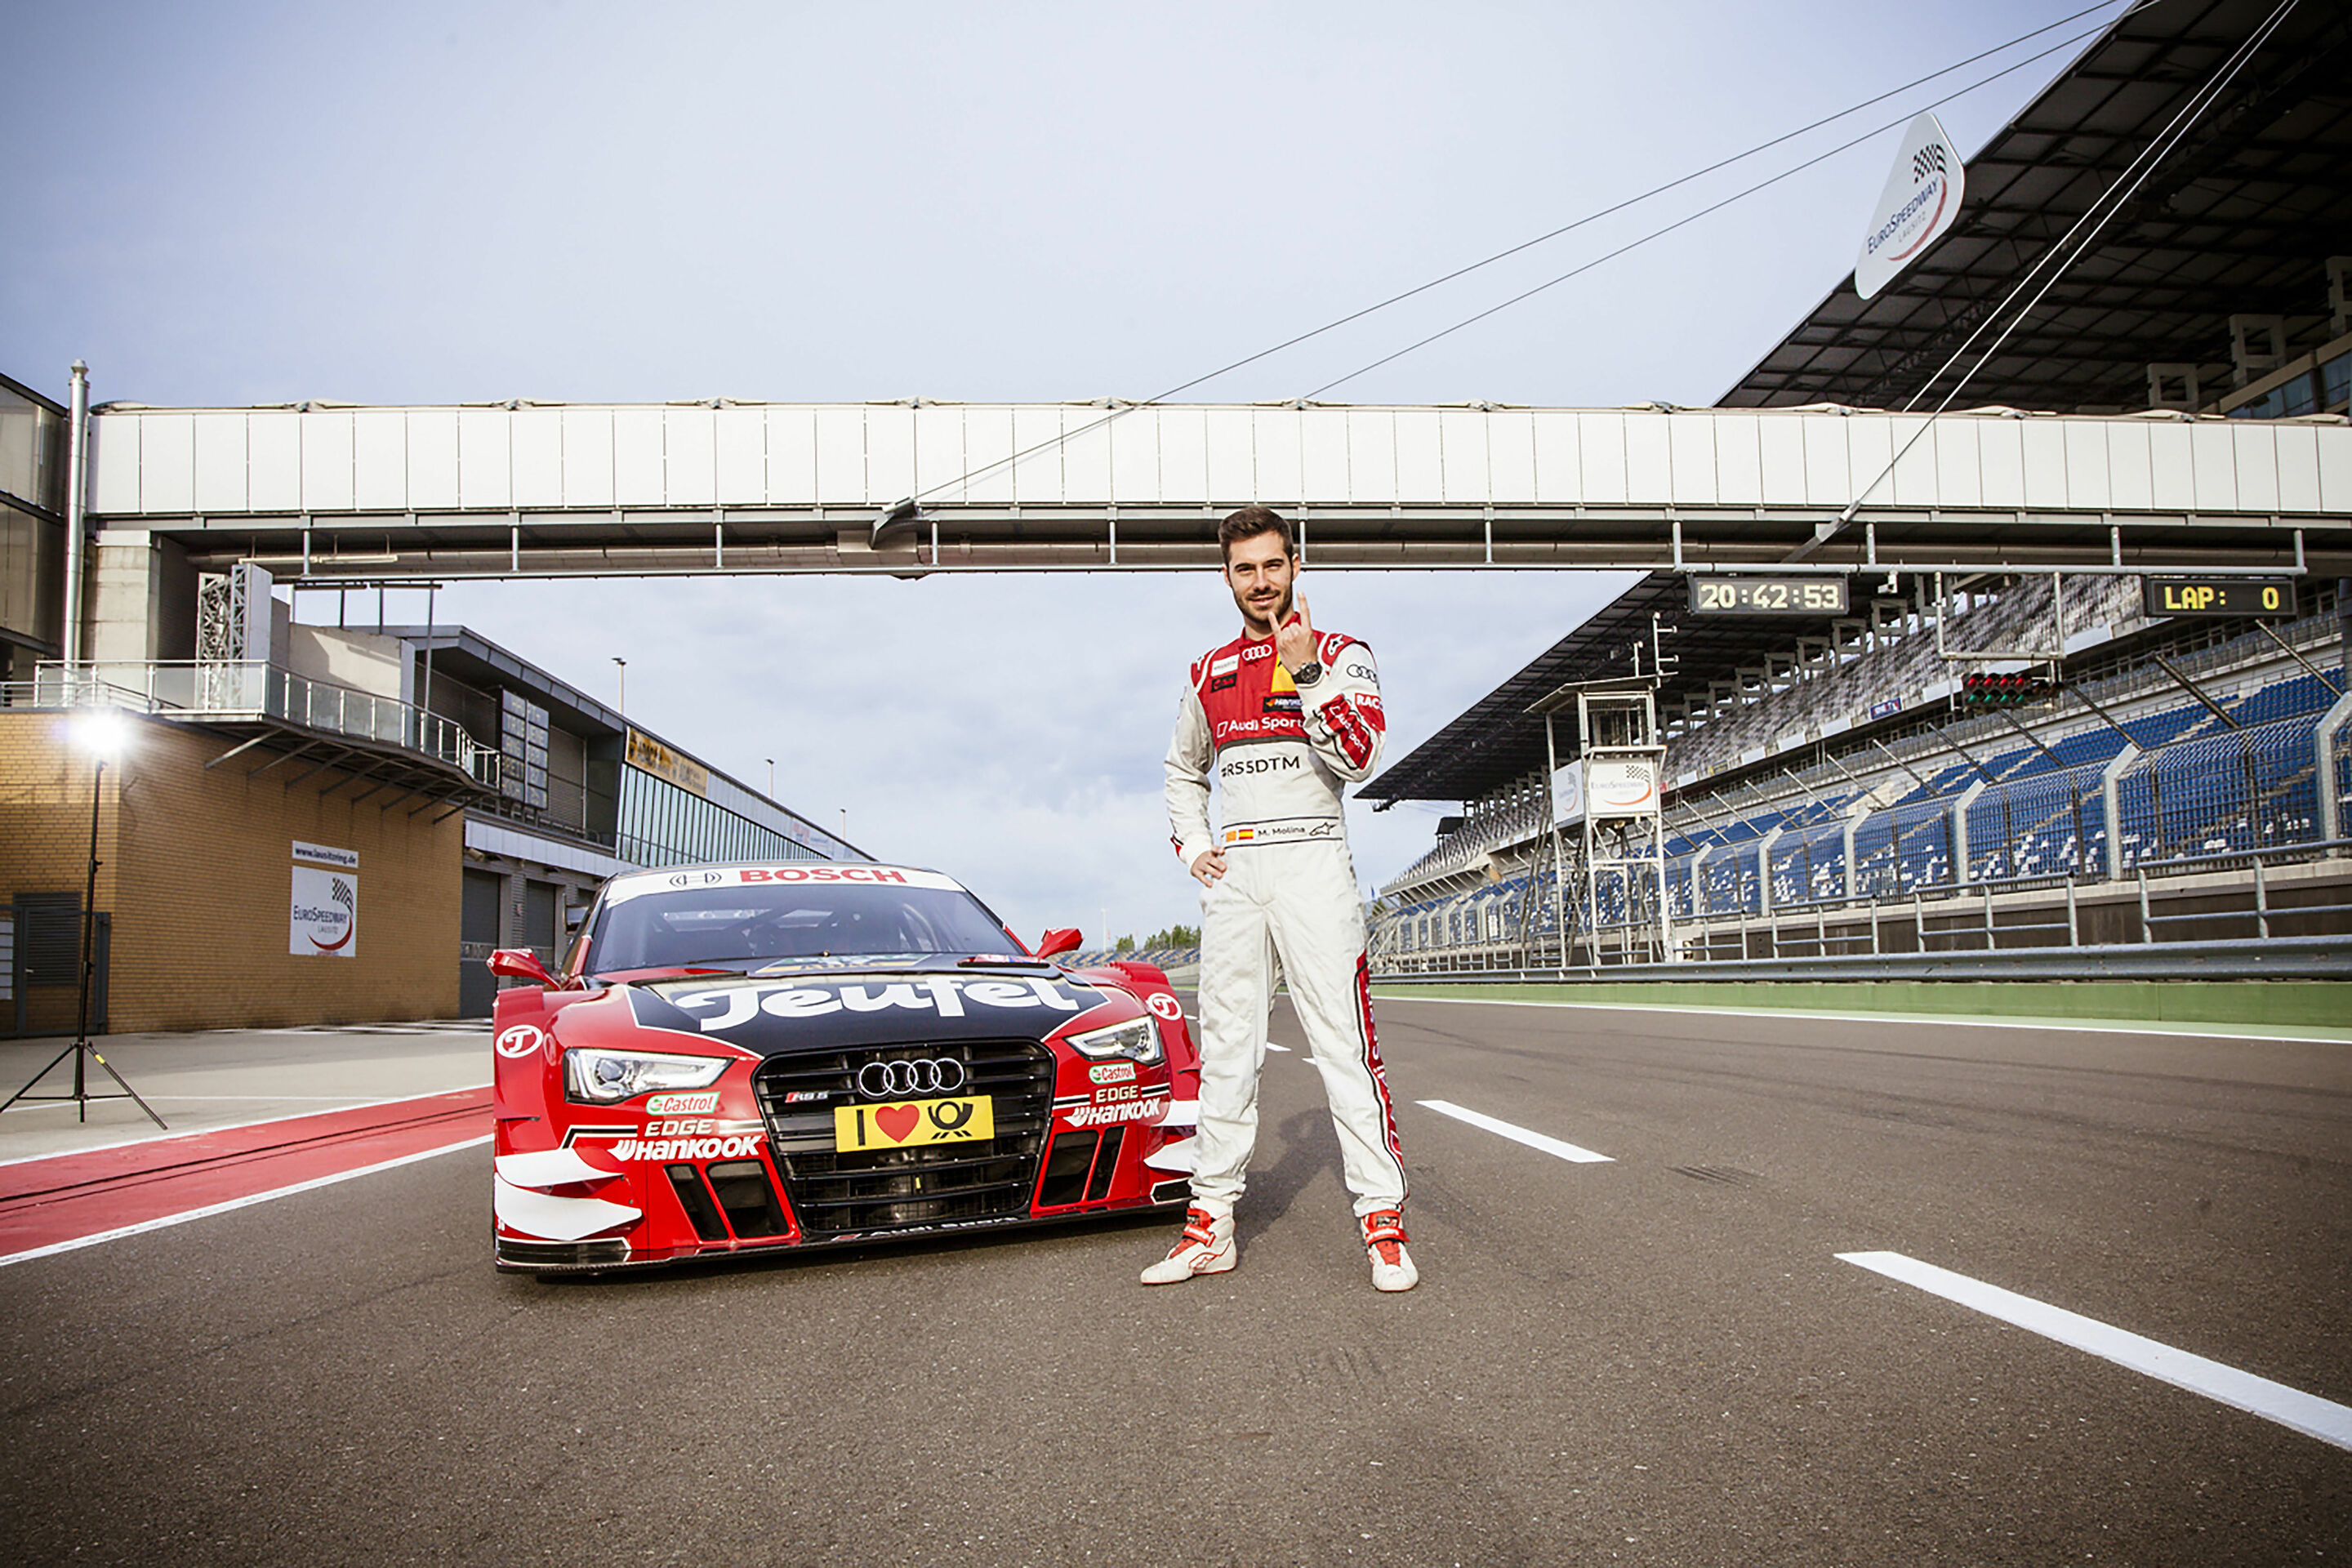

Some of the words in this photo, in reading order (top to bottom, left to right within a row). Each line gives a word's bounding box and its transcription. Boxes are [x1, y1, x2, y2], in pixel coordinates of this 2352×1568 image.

[1700, 584, 1839, 608] 20:42:53
[2164, 586, 2226, 610] LAP:
[2261, 586, 2279, 610] 0
[1228, 719, 1258, 732] Audi
[1261, 716, 1303, 731] Sport
[1272, 826, 1306, 835] Molina
[739, 869, 908, 884] BOSCH
[675, 976, 1080, 1031] Teufel
[1101, 1065, 1134, 1081] Castrol
[1095, 1085, 1139, 1103] EDGE
[663, 1095, 714, 1112] Castrol
[644, 1119, 716, 1137] EDGE
